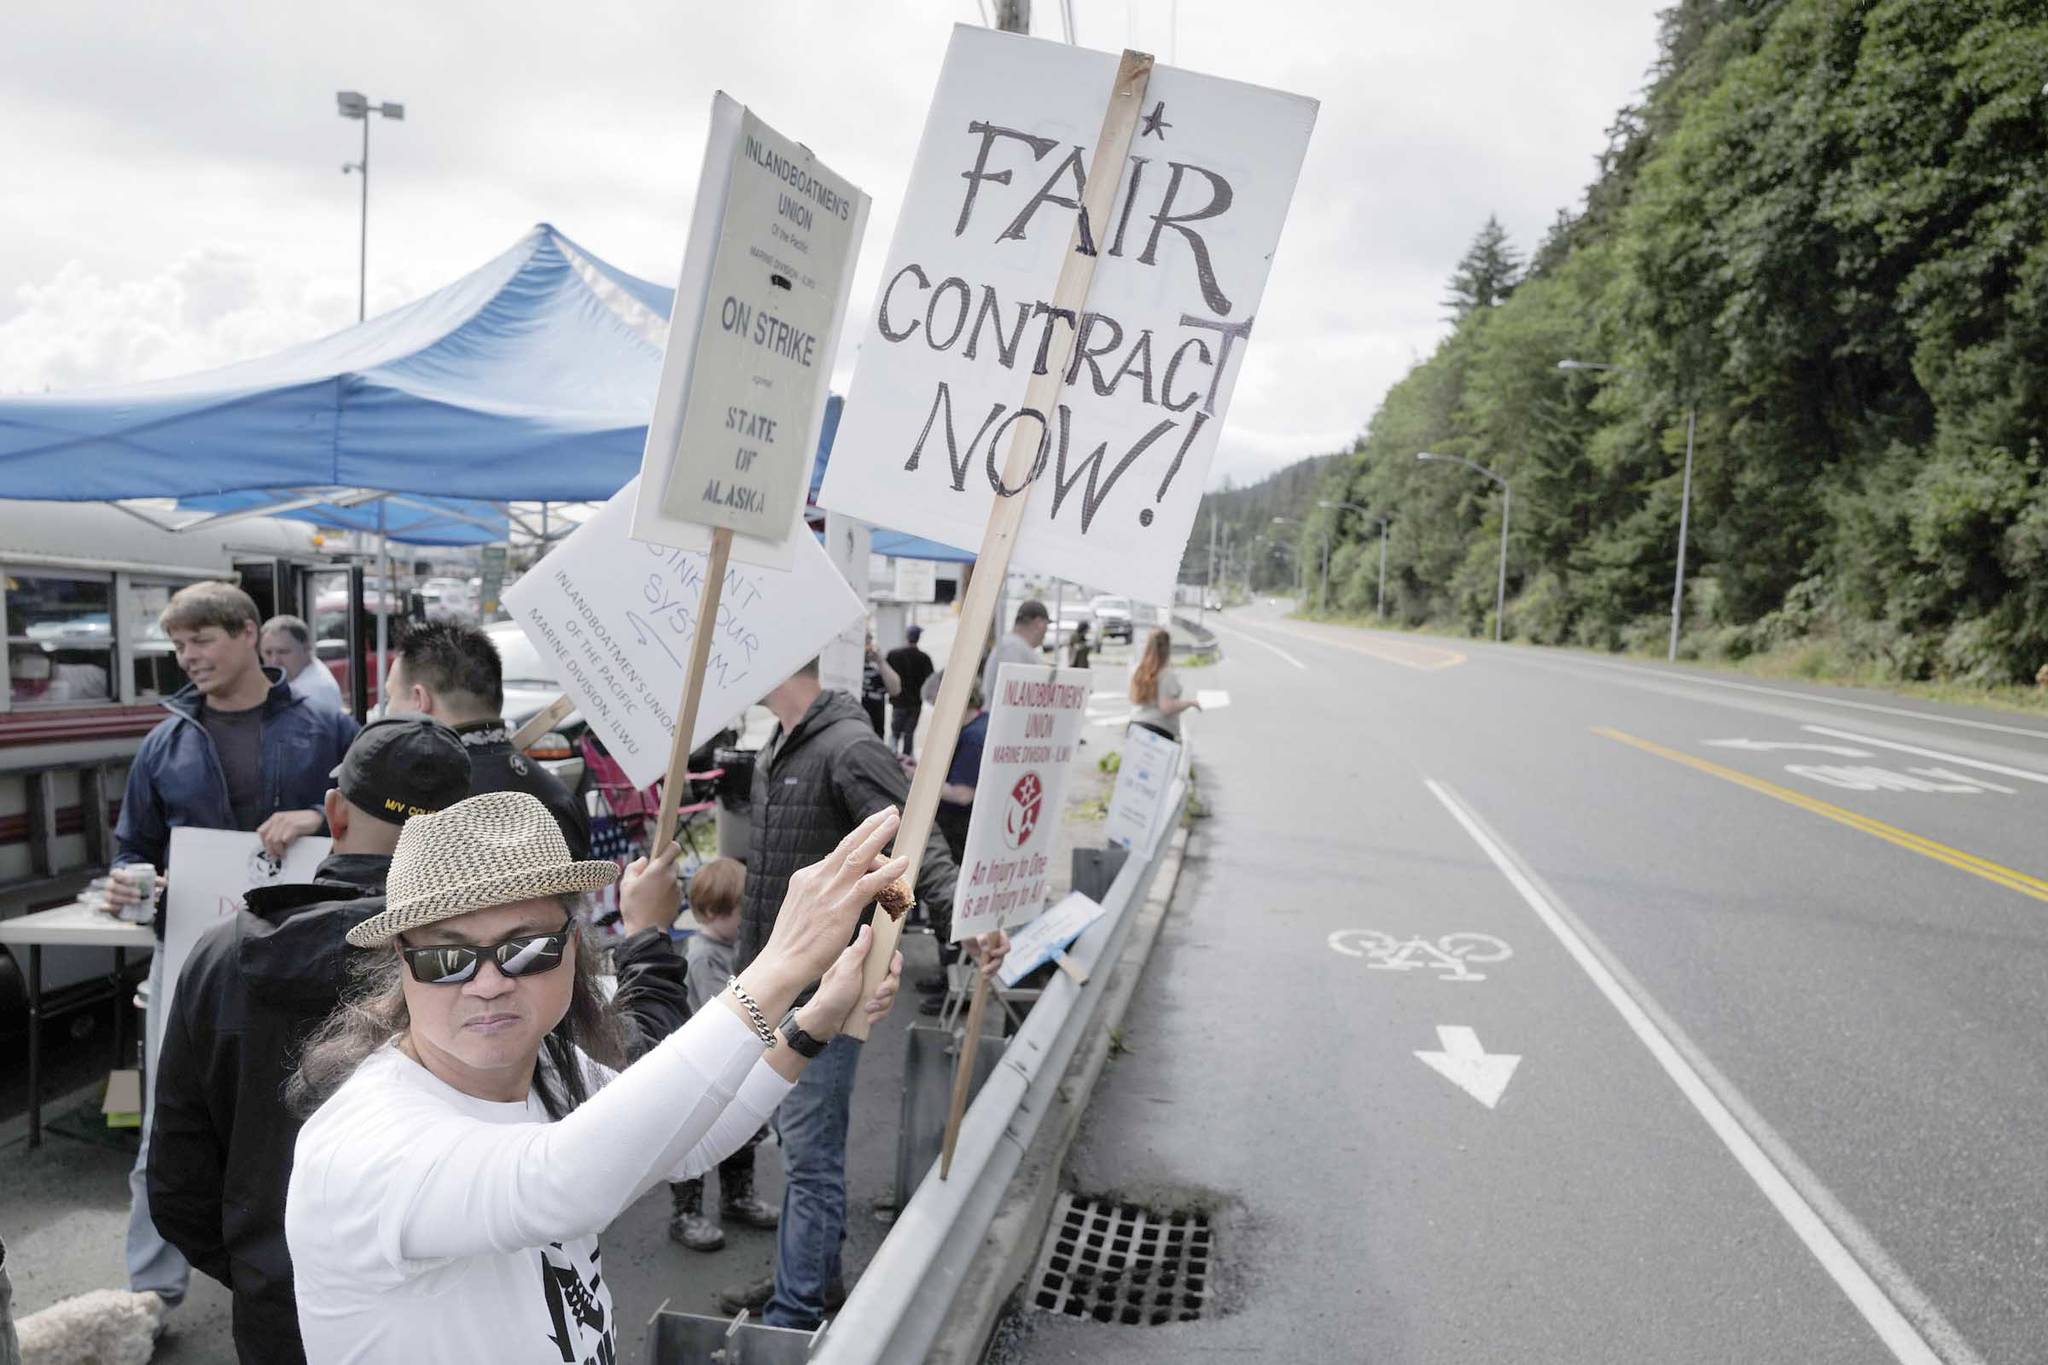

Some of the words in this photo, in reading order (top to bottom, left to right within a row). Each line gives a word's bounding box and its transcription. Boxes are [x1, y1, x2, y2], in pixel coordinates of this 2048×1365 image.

[745, 135, 850, 221] INLANDBOATMEN'S
[778, 193, 813, 232] UNION
[956, 117, 1233, 316] FAIR
[721, 296, 751, 338] ON
[754, 311, 816, 367] STRIKE
[878, 263, 1254, 417] CONTRACT
[725, 406, 777, 443] STATE
[735, 447, 758, 472] OF
[904, 381, 1209, 535] NOW!
[702, 479, 765, 515] ALASKA
[554, 569, 647, 693] INLANDBOATMEN'S
[528, 608, 569, 661] MARINE
[609, 719, 640, 755] ILWU
[566, 620, 583, 638] OF
[580, 640, 602, 665] THE
[598, 665, 640, 715] PACIFIC
[1025, 714, 1055, 738] UNION
[993, 746, 1022, 763] MARINE
[1022, 746, 1051, 763] DIVISION
[385, 798, 406, 814] M/V
[969, 859, 986, 888] An
[1016, 857, 1029, 878] to
[1028, 852, 1048, 876] One
[961, 893, 974, 920] is
[973, 895, 990, 917] an
